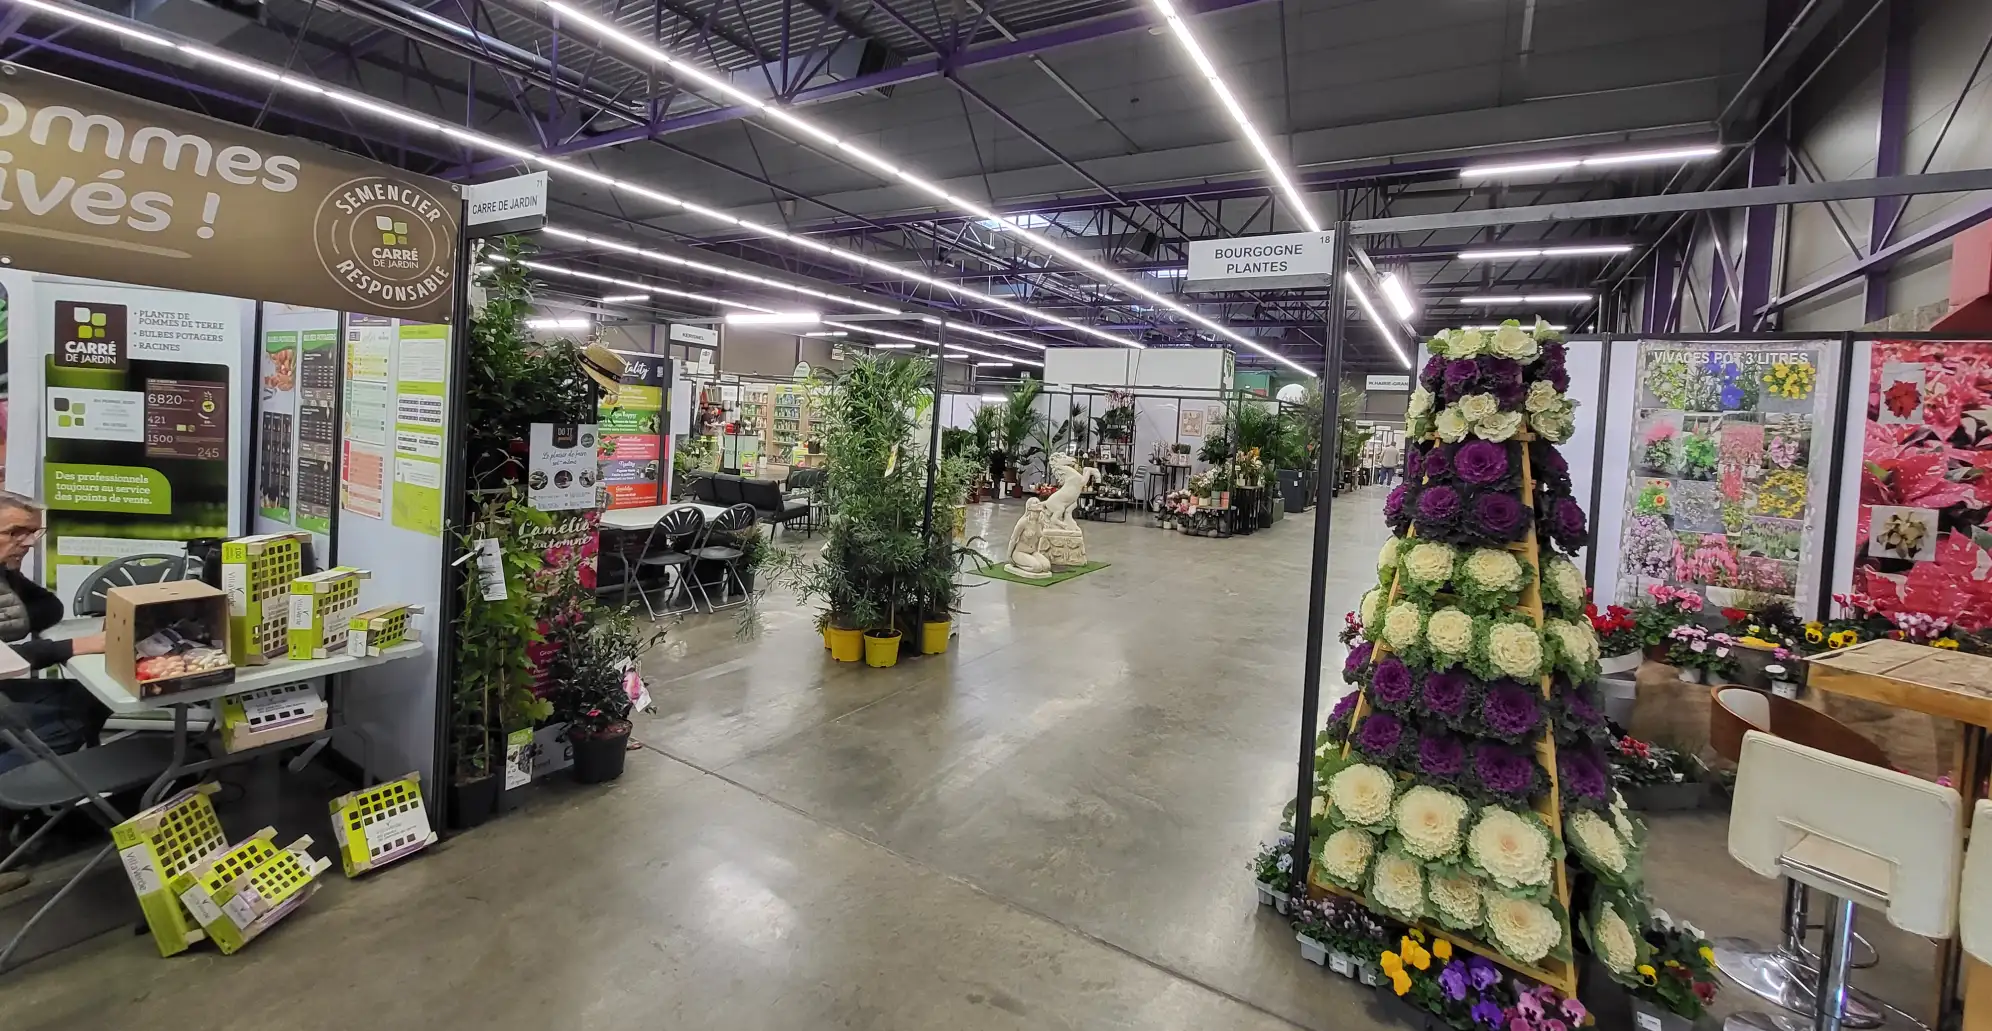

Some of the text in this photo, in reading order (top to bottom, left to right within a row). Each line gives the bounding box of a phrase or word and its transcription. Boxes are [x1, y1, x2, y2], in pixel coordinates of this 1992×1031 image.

[536, 179, 543, 187] 71
[335, 183, 441, 222] SEMENCIER
[472, 195, 538, 215] CARRE DE JARDIN
[196, 192, 221, 239] !
[1319, 235, 1331, 244] 18
[371, 247, 419, 261] CARRÉ
[1215, 244, 1303, 259] BOURGOGNE
[373, 259, 419, 269] DE JARDIN
[1226, 261, 1288, 274] PLANTES
[336, 265, 450, 301] RESPONSABLE
[139, 310, 190, 320] PLANTS DE
[139, 318, 224, 330] POMMES DE TERRE
[139, 330, 224, 342] BULBES POTAGERS
[65, 340, 117, 356] CARRÉ
[139, 342, 180, 351] RACINES
[66, 354, 117, 364] DE JARDIN
[1654, 351, 1809, 365] VIVACES POT 3 LITRES
[624, 361, 651, 380] tality
[148, 394, 183, 405] 6820
[148, 415, 166, 424] 421
[148, 434, 173, 443] 1500
[198, 447, 220, 458] 245
[55, 471, 149, 485] Des professionnels
[56, 482, 100, 494] toujours
[115, 485, 151, 495] service
[55, 492, 152, 505] des points de vente.
